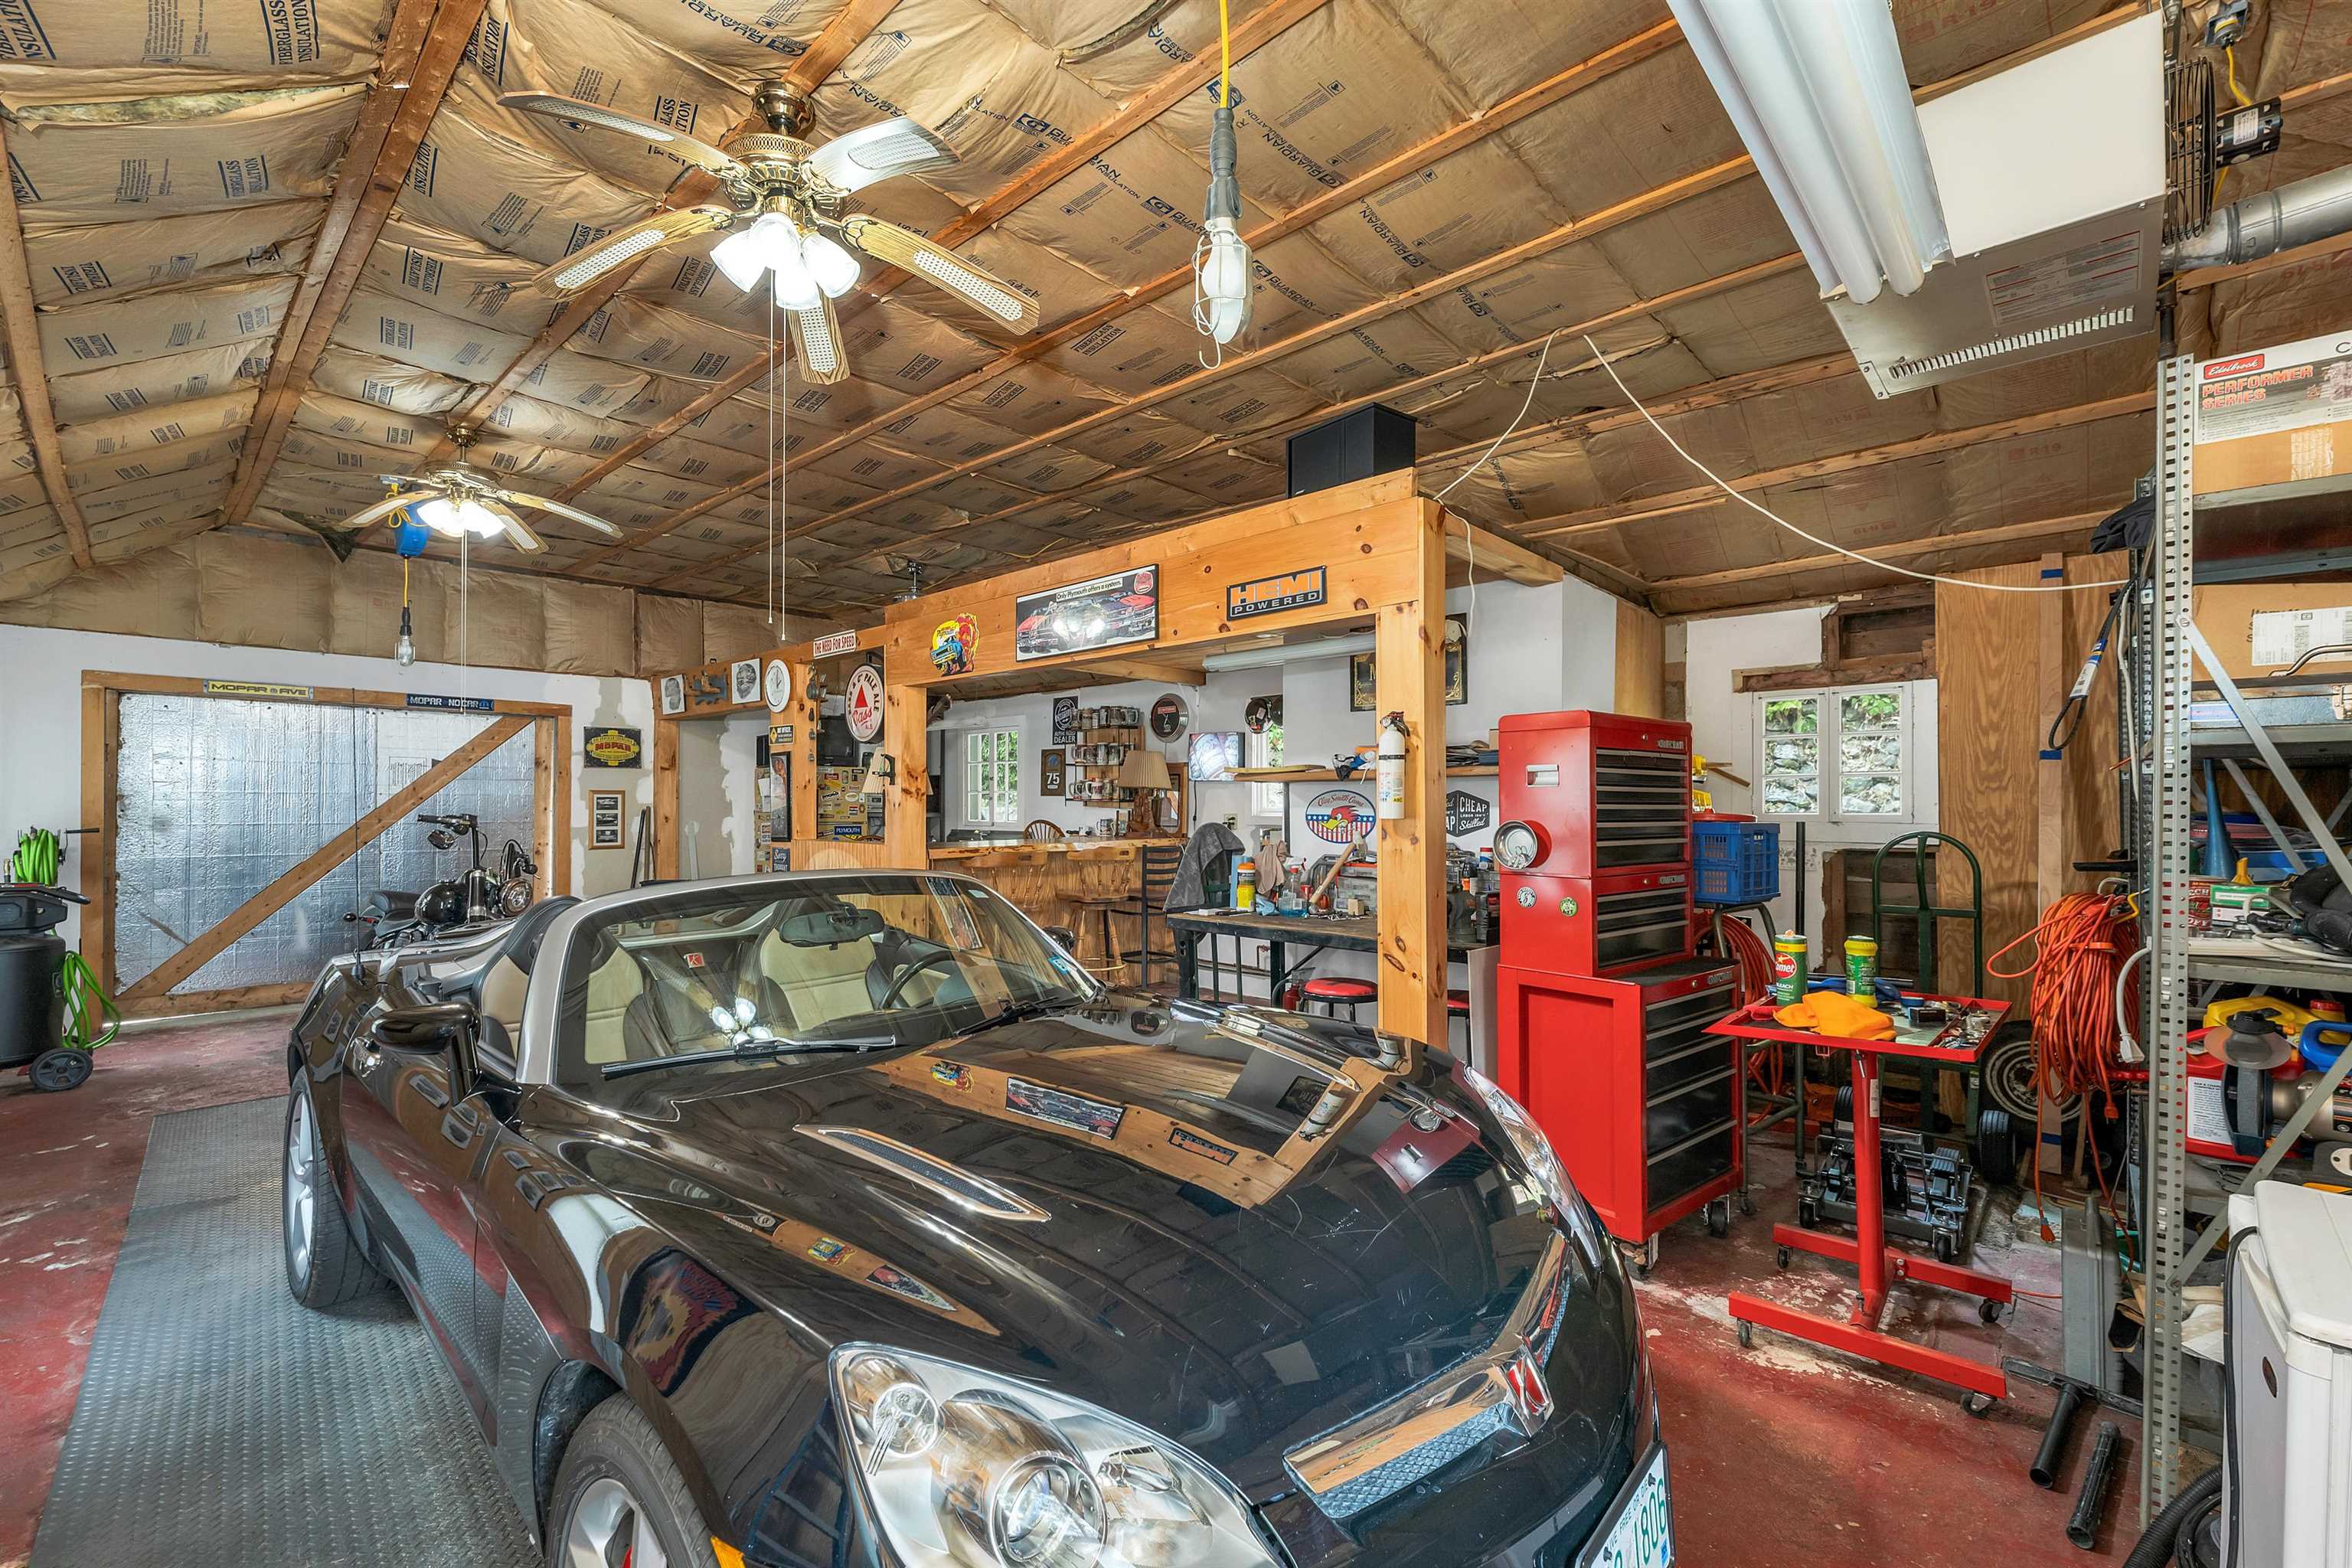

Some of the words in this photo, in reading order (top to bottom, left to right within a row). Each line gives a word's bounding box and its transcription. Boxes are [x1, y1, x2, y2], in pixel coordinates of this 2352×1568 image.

[1073, 324, 1115, 354] FIBERGLASS
[1083, 328, 1122, 356] INSULATION
[2208, 358, 2259, 375] Edelbrock
[2202, 365, 2313, 397] PERFORMER
[2202, 388, 2266, 410] SERIES
[1067, 588, 1087, 597] Plymouth
[1230, 569, 1321, 606] HEMI
[1234, 593, 1318, 614] POWERED
[822, 640, 832, 653] NEED
[841, 635, 854, 649] SPEED
[211, 683, 268, 694] MOPAR
[864, 674, 876, 691] PALE
[410, 696, 442, 707] MOPAR
[1047, 773, 1060, 784] 75
[1331, 794, 1348, 802] Smith
[1460, 796, 1488, 812] CHEAP
[1459, 818, 1485, 831] Skilled
[1620, 1508, 1632, 1533] FREE
[1633, 1494, 1640, 1511] OR
